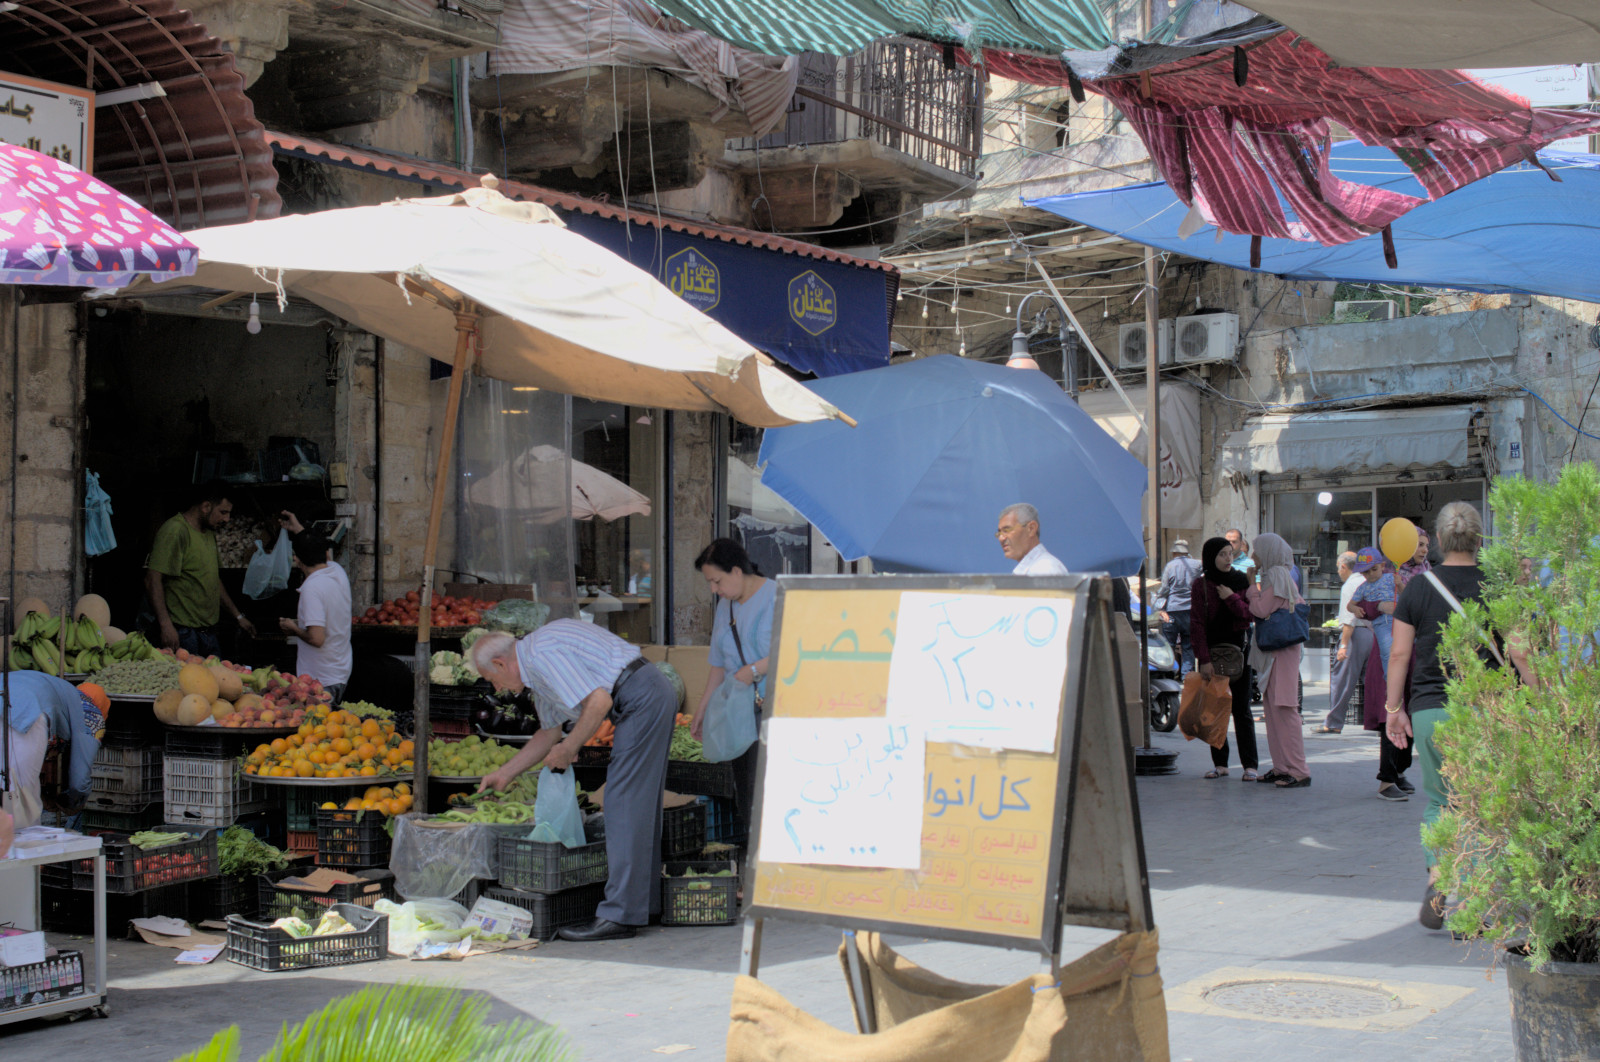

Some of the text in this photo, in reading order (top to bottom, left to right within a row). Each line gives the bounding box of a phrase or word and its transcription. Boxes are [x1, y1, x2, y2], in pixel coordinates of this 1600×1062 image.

[670, 261, 716, 297] عدنان
[695, 264, 715, 278] دكان
[793, 283, 833, 318] عدنان
[924, 770, 1032, 821] كل انوا
[831, 887, 884, 907] كمون
